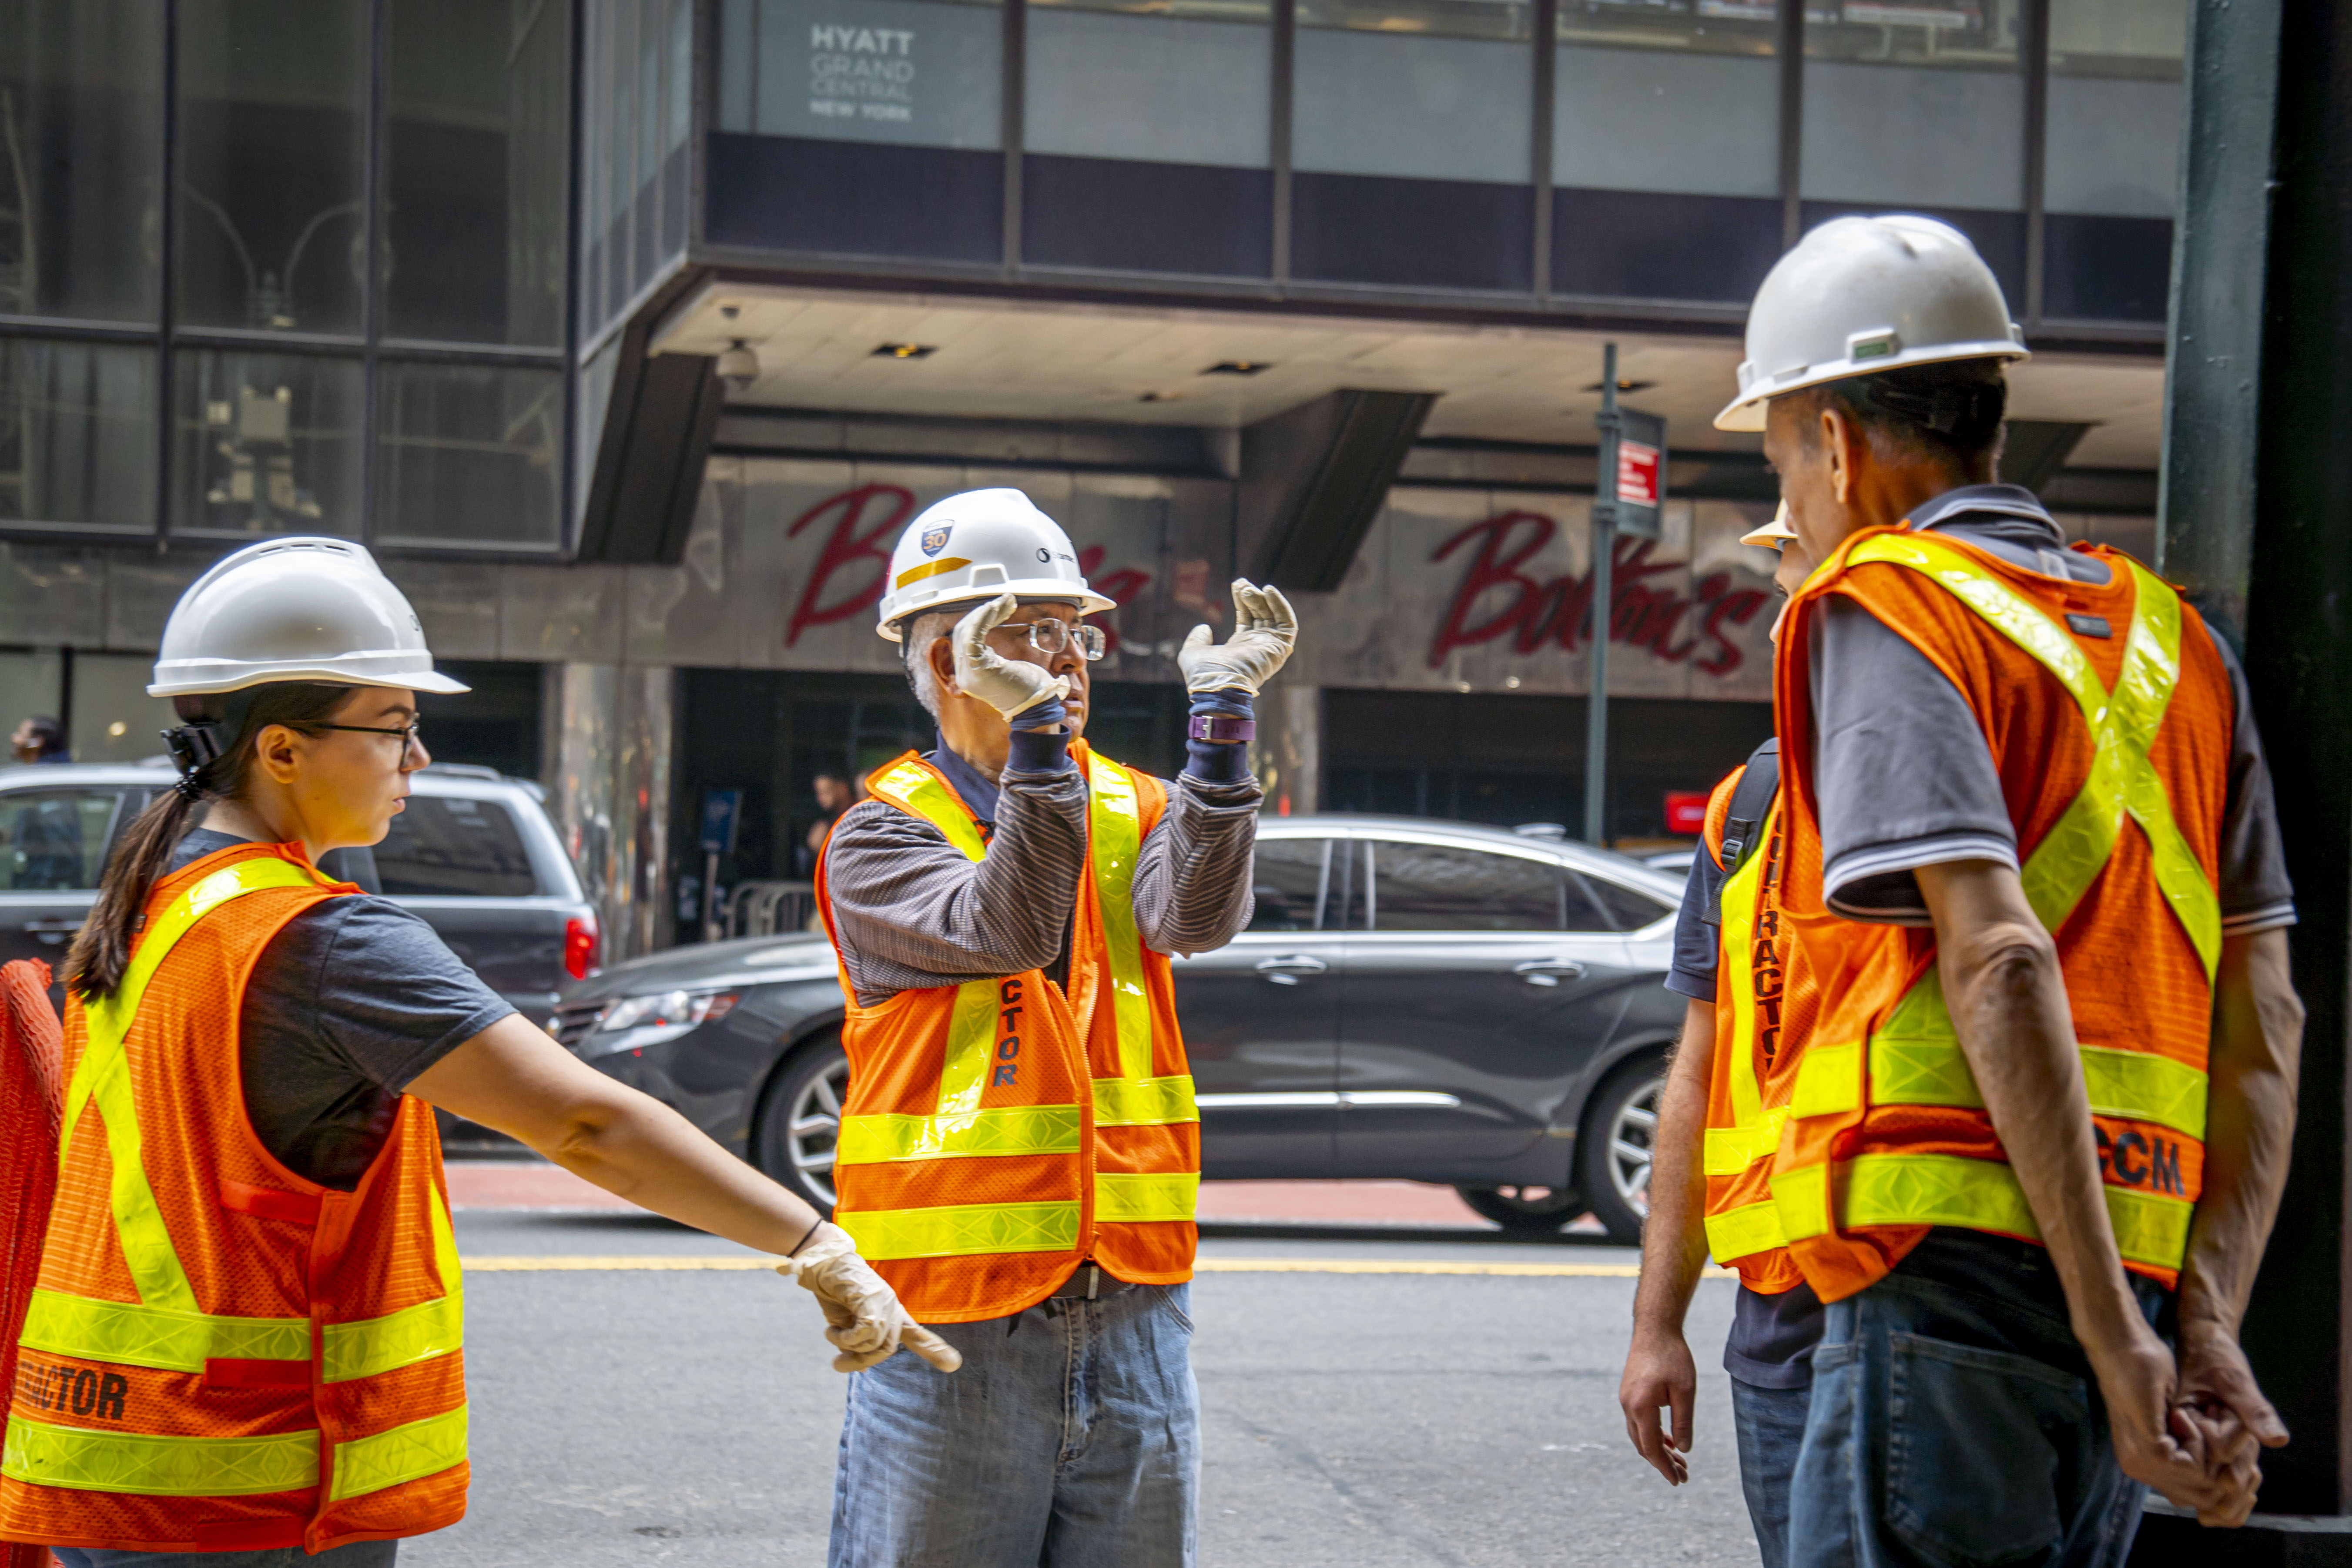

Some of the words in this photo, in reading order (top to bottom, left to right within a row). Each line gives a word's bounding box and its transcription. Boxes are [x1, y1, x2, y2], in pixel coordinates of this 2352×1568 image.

[811, 24, 915, 56] HYATT
[810, 53, 915, 83] GRAND
[810, 77, 913, 103] CENTRAL
[809, 101, 854, 117] NEW
[861, 104, 912, 122] YORK
[923, 533, 947, 550] 30
[993, 980, 1022, 1087] CTOR
